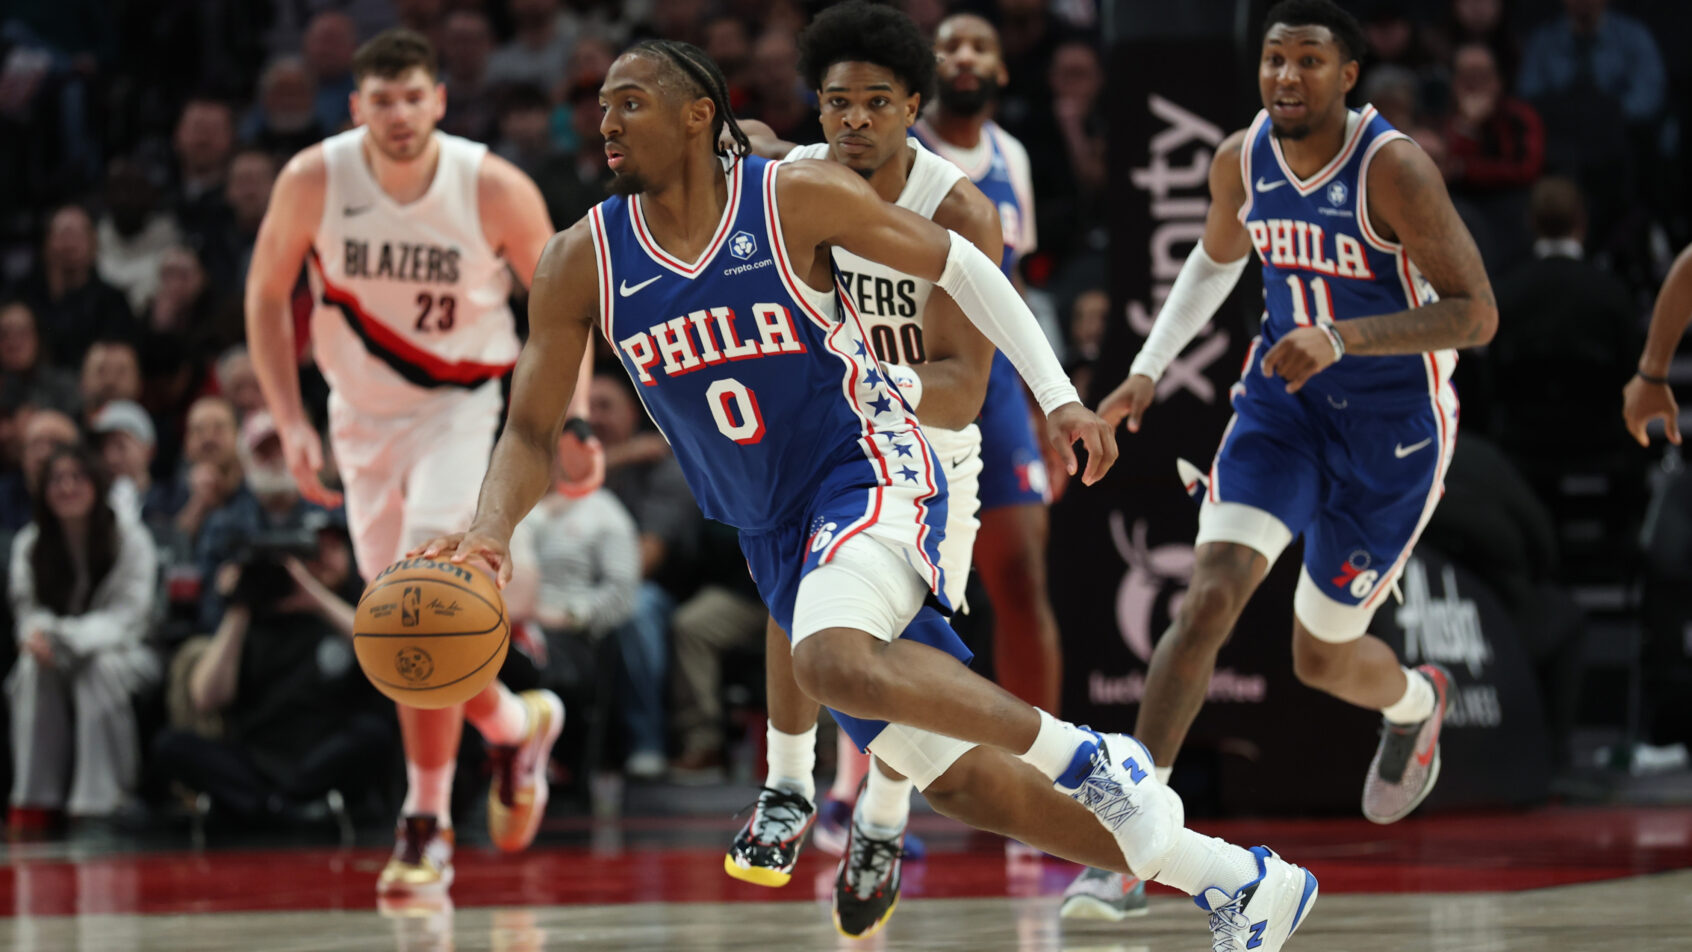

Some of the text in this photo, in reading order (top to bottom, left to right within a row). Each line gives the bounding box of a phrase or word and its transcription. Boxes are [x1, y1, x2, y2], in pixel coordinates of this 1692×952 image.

[343, 240, 460, 283] BLAZERS
[723, 258, 773, 276] crypto.com
[1246, 218, 1375, 280] PHILA
[415, 291, 456, 332] 23
[1286, 274, 1334, 327] 11
[619, 302, 807, 386] PHILA
[871, 323, 926, 365] 00
[705, 378, 766, 445] 0
[1331, 560, 1378, 598] 76
